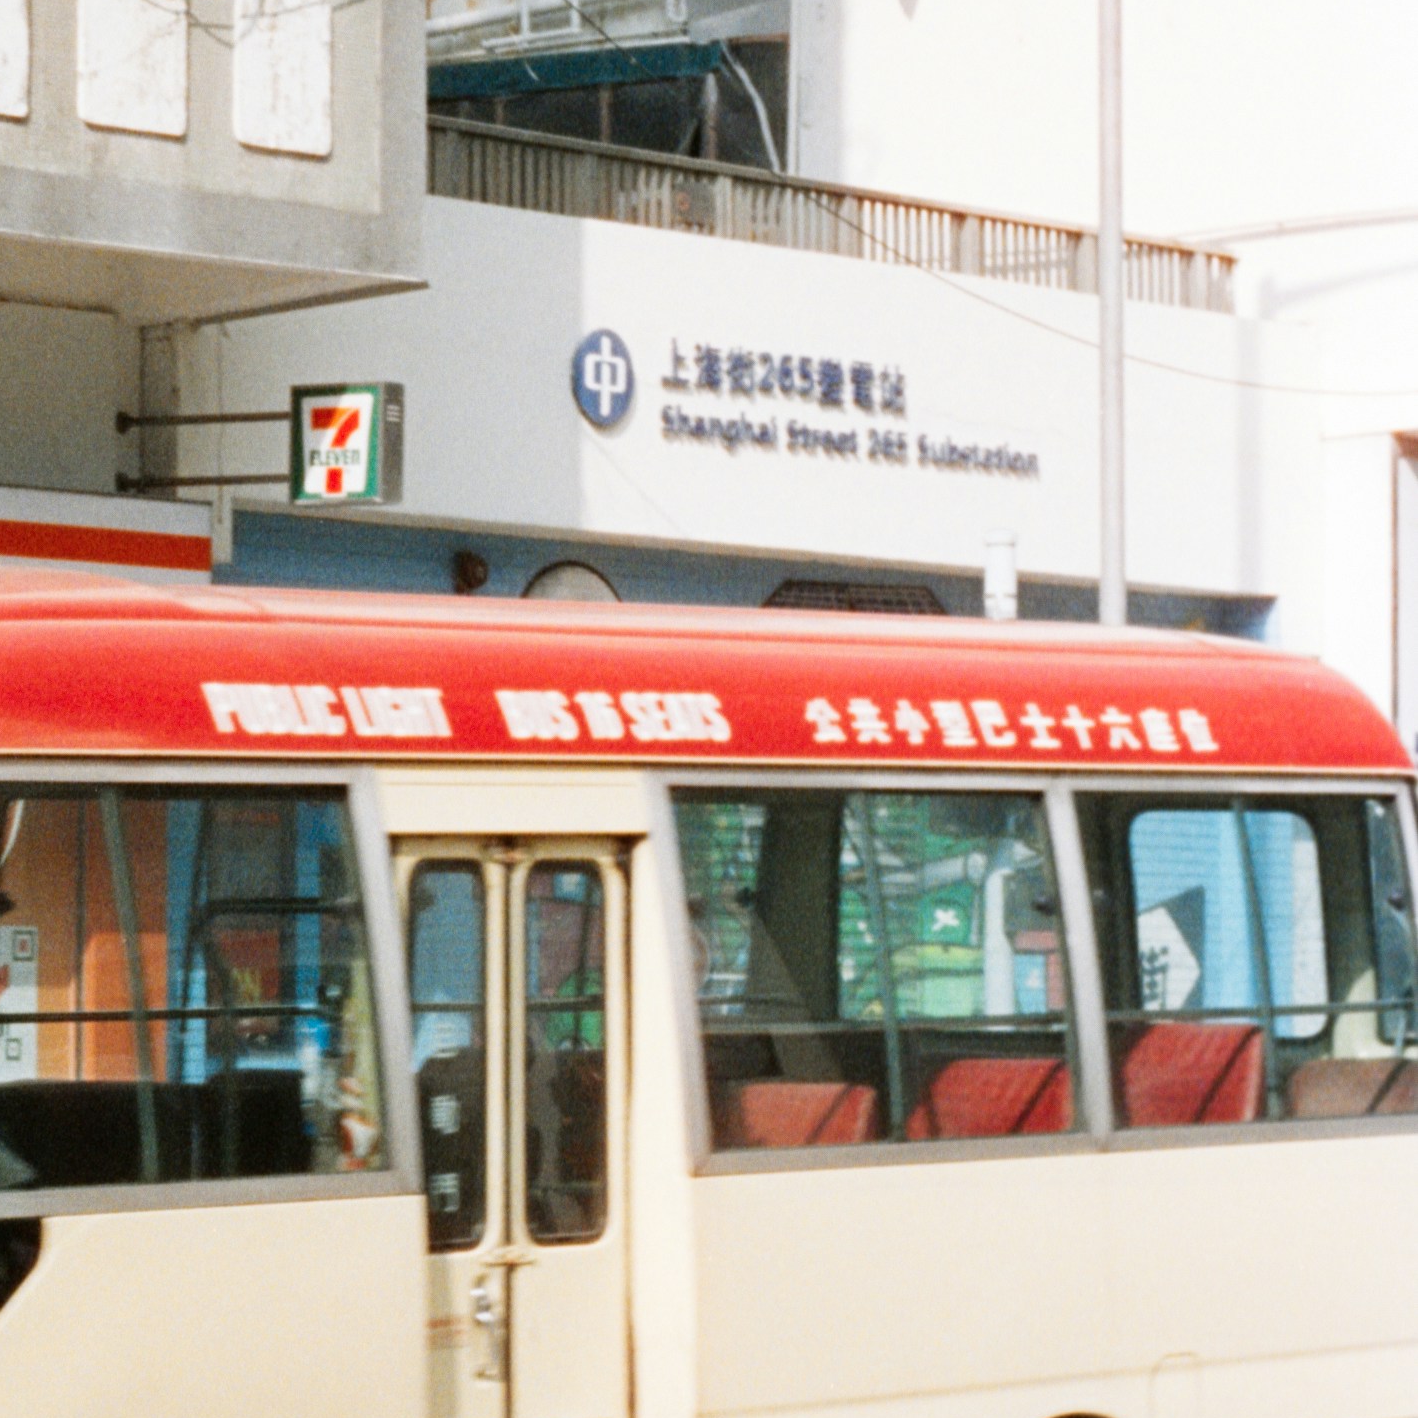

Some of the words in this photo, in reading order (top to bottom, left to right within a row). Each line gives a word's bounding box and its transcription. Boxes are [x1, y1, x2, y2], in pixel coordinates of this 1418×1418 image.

[310, 406, 361, 494] 7
[661, 405, 777, 456] Shanghai
[786, 419, 859, 459] Street
[868, 428, 908, 466] 265
[918, 433, 1041, 482] Substation
[494, 689, 580, 741] BUS
